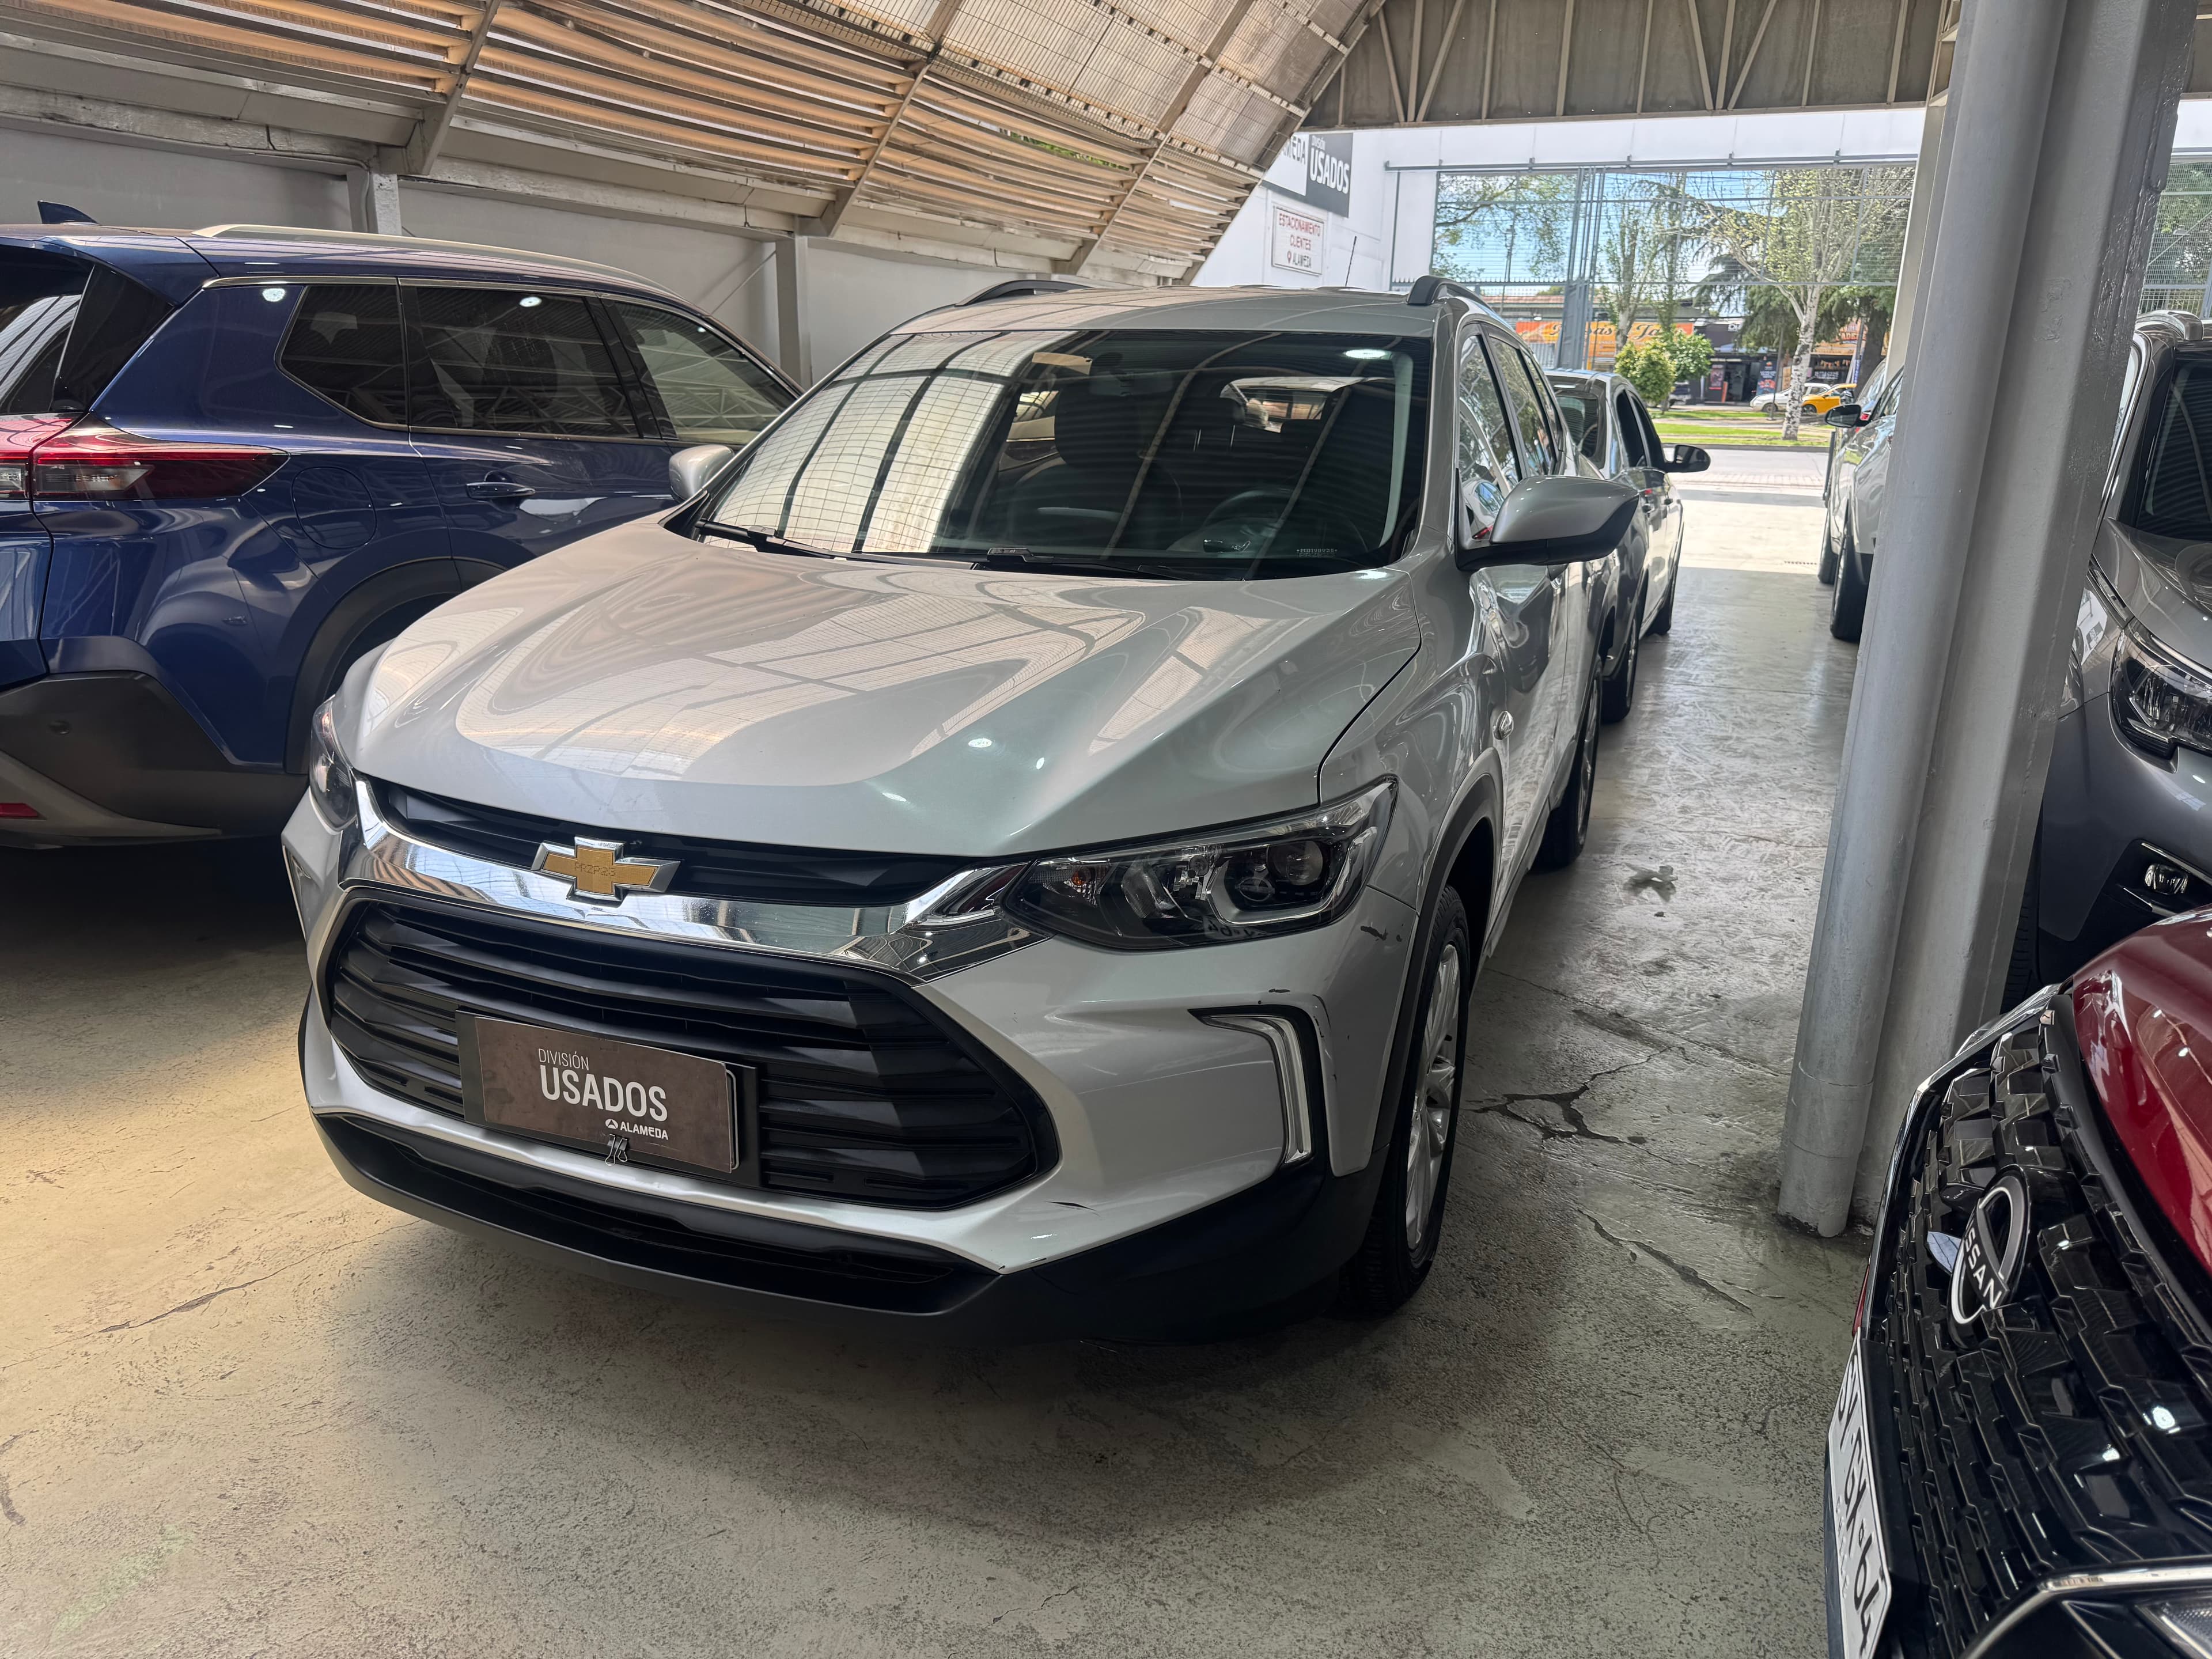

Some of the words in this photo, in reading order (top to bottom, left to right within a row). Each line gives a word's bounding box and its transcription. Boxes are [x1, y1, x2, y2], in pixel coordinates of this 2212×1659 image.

[1309, 147, 1350, 195] USADOS
[1279, 213, 1321, 237] ESTACIONAMIENTO
[1290, 234, 1312, 251] CLIENTES
[538, 1047, 589, 1071] DIVISIÓN
[539, 1065, 668, 1122] USADOS
[620, 1121, 669, 1141] ALAMEDA
[1965, 1213, 2003, 1310] ISSAN
